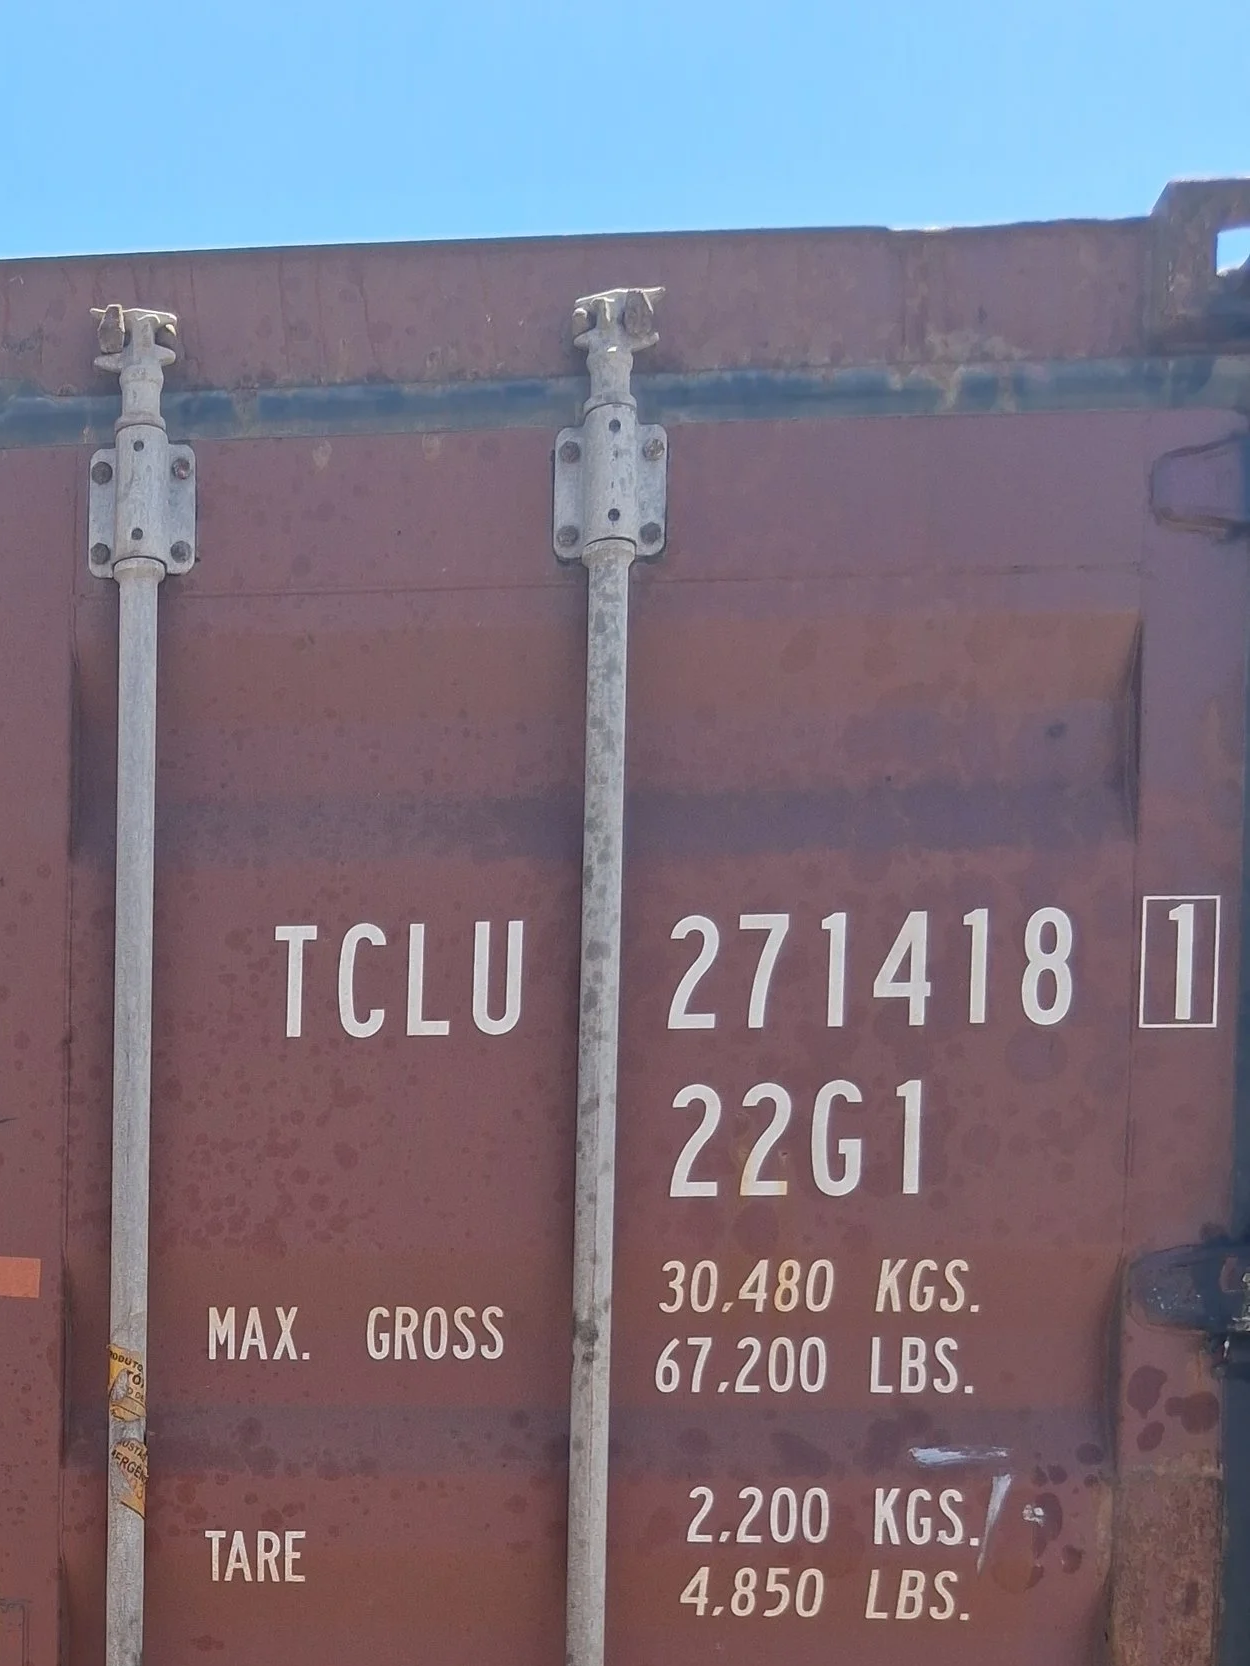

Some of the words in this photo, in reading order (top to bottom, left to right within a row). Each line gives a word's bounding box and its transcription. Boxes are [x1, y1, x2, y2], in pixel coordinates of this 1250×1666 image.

[275, 920, 524, 1037] TCLU
[667, 907, 1073, 1030] 271418
[1168, 903, 1196, 1020] 1
[669, 1079, 922, 1198] 22G1
[659, 1259, 835, 1314] 30,480
[875, 1258, 980, 1313] KGS.
[208, 1306, 310, 1360] MAX.
[366, 1306, 504, 1360] GROSS
[655, 1336, 827, 1394] 67,200
[870, 1336, 974, 1394] LBS.
[686, 1486, 830, 1545] 2,200
[874, 1487, 980, 1547] KGS.
[204, 1530, 306, 1582] TARE
[680, 1566, 824, 1618] 4,850
[865, 1569, 970, 1621] LBS.
